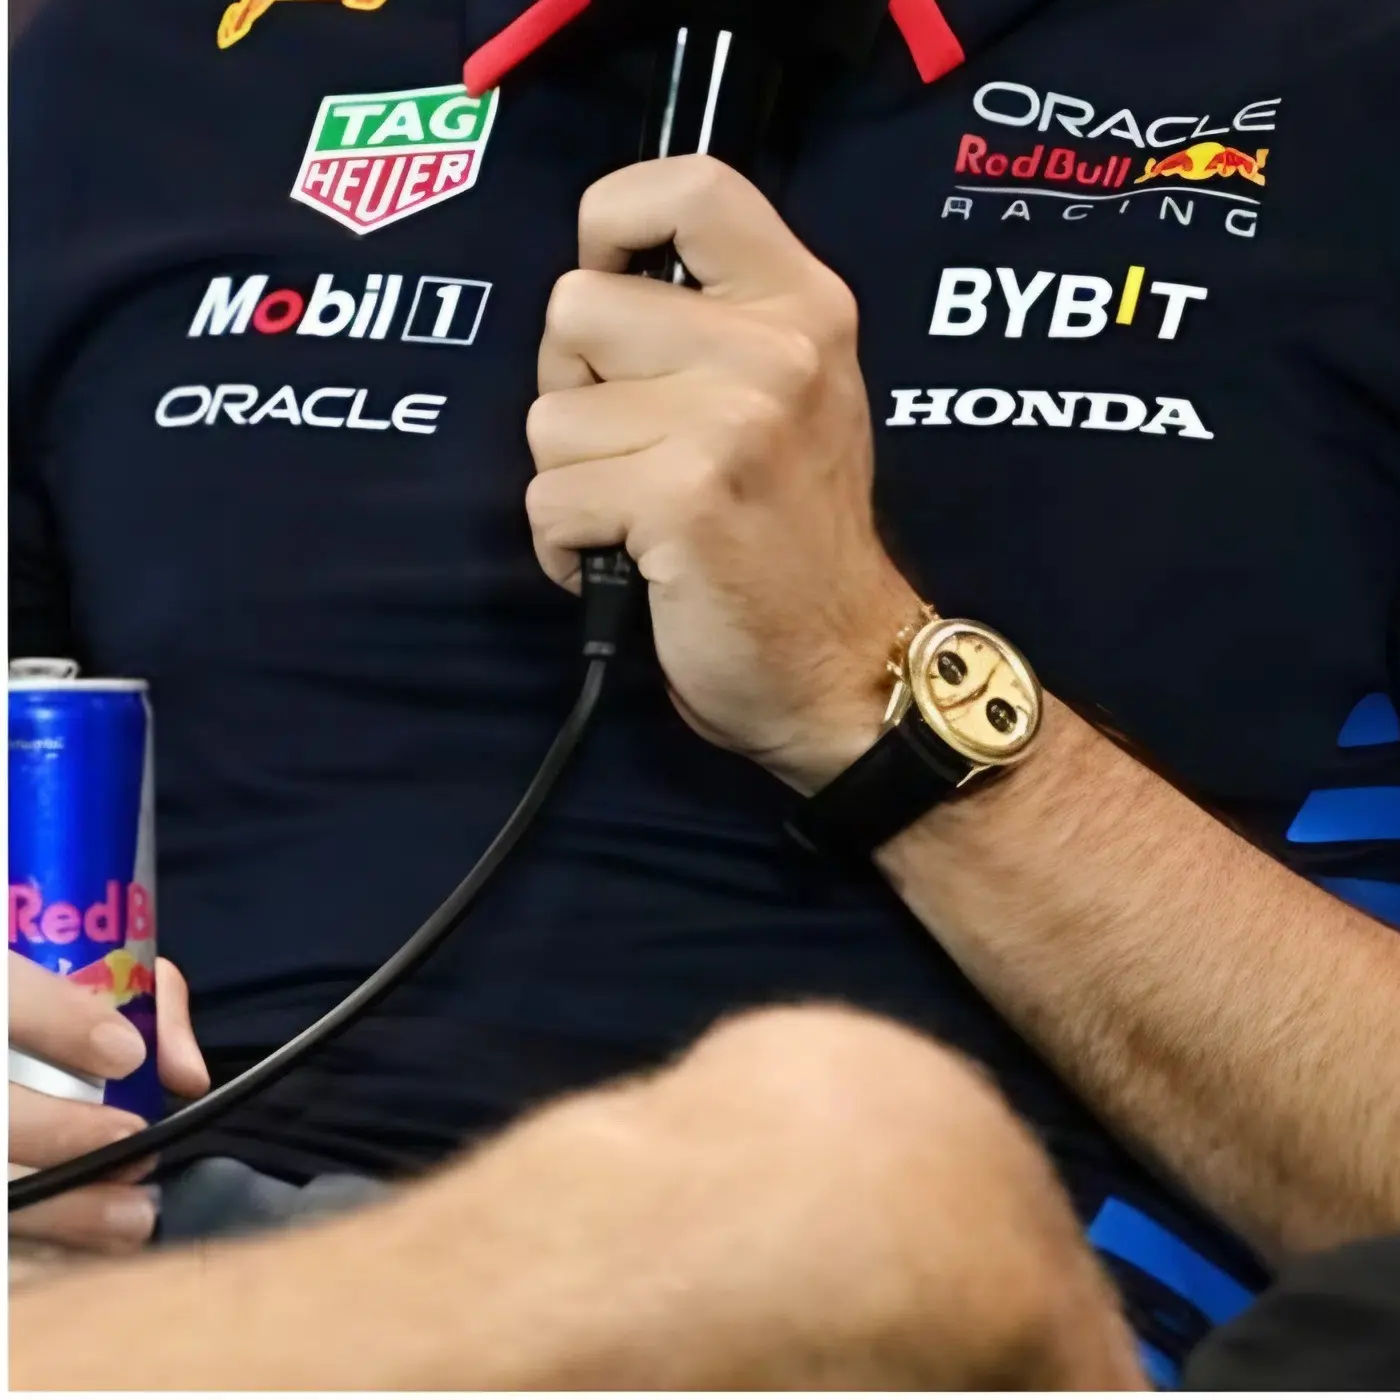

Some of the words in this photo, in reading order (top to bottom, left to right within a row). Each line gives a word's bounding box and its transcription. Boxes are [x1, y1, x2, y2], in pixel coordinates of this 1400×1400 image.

[332, 97, 481, 144] TAG
[973, 81, 1281, 148] ORACLE
[303, 153, 467, 223] HEUER
[188, 273, 403, 339] Mobil
[928, 266, 1208, 340] BYBIT
[154, 383, 447, 434] ORACLE
[885, 388, 1215, 440] HONDA
